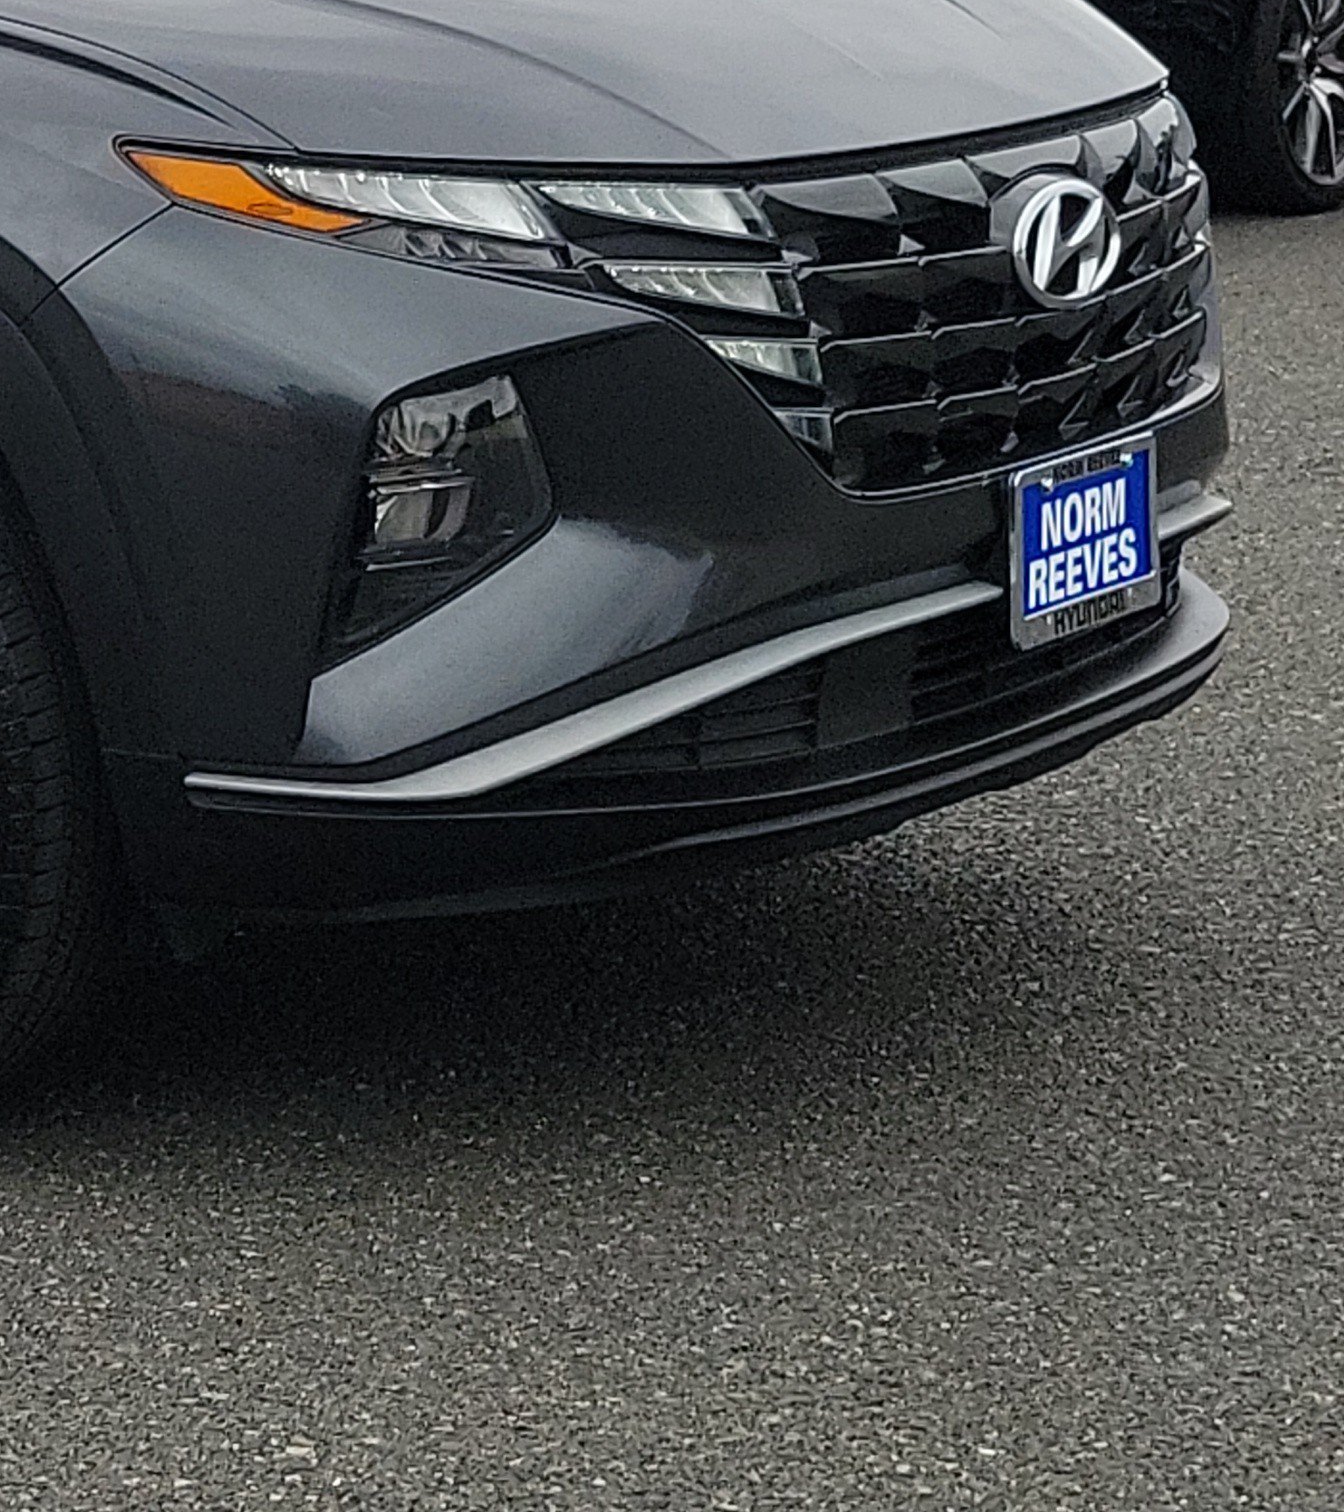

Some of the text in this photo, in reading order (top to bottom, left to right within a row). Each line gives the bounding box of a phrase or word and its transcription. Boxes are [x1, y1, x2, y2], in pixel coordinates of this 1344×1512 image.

[1041, 477, 1126, 552] NORM
[1028, 527, 1138, 610] REEVES
[1053, 588, 1126, 635] HYUNDAI
